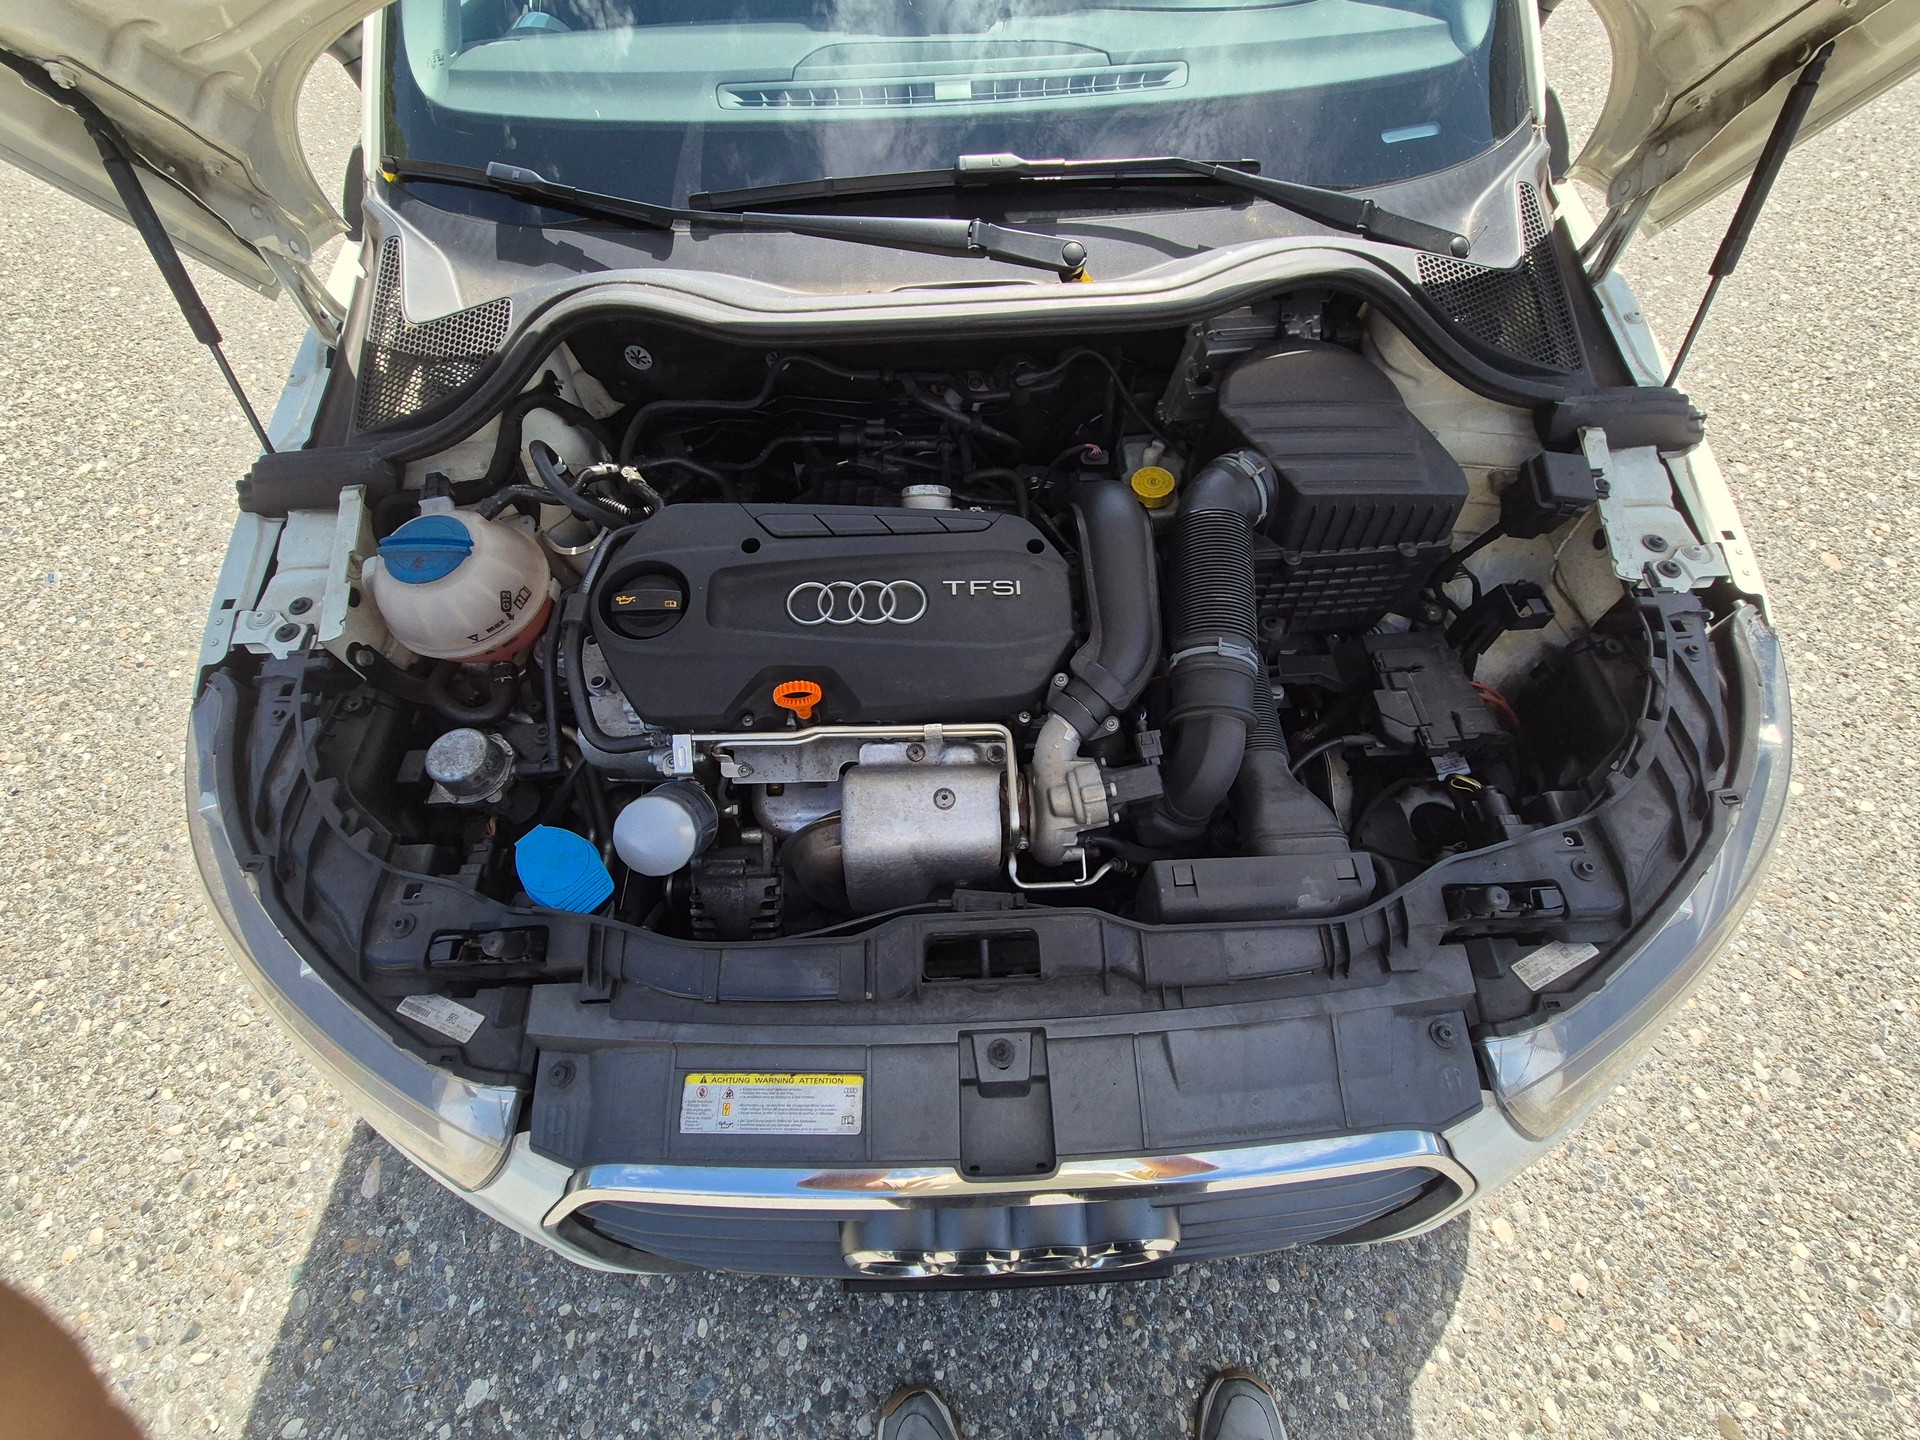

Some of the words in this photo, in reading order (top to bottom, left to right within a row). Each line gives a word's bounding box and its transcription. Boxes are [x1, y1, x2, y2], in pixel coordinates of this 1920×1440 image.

[942, 580, 1021, 596] TFSI
[502, 592, 511, 610] G12
[486, 620, 505, 633] max
